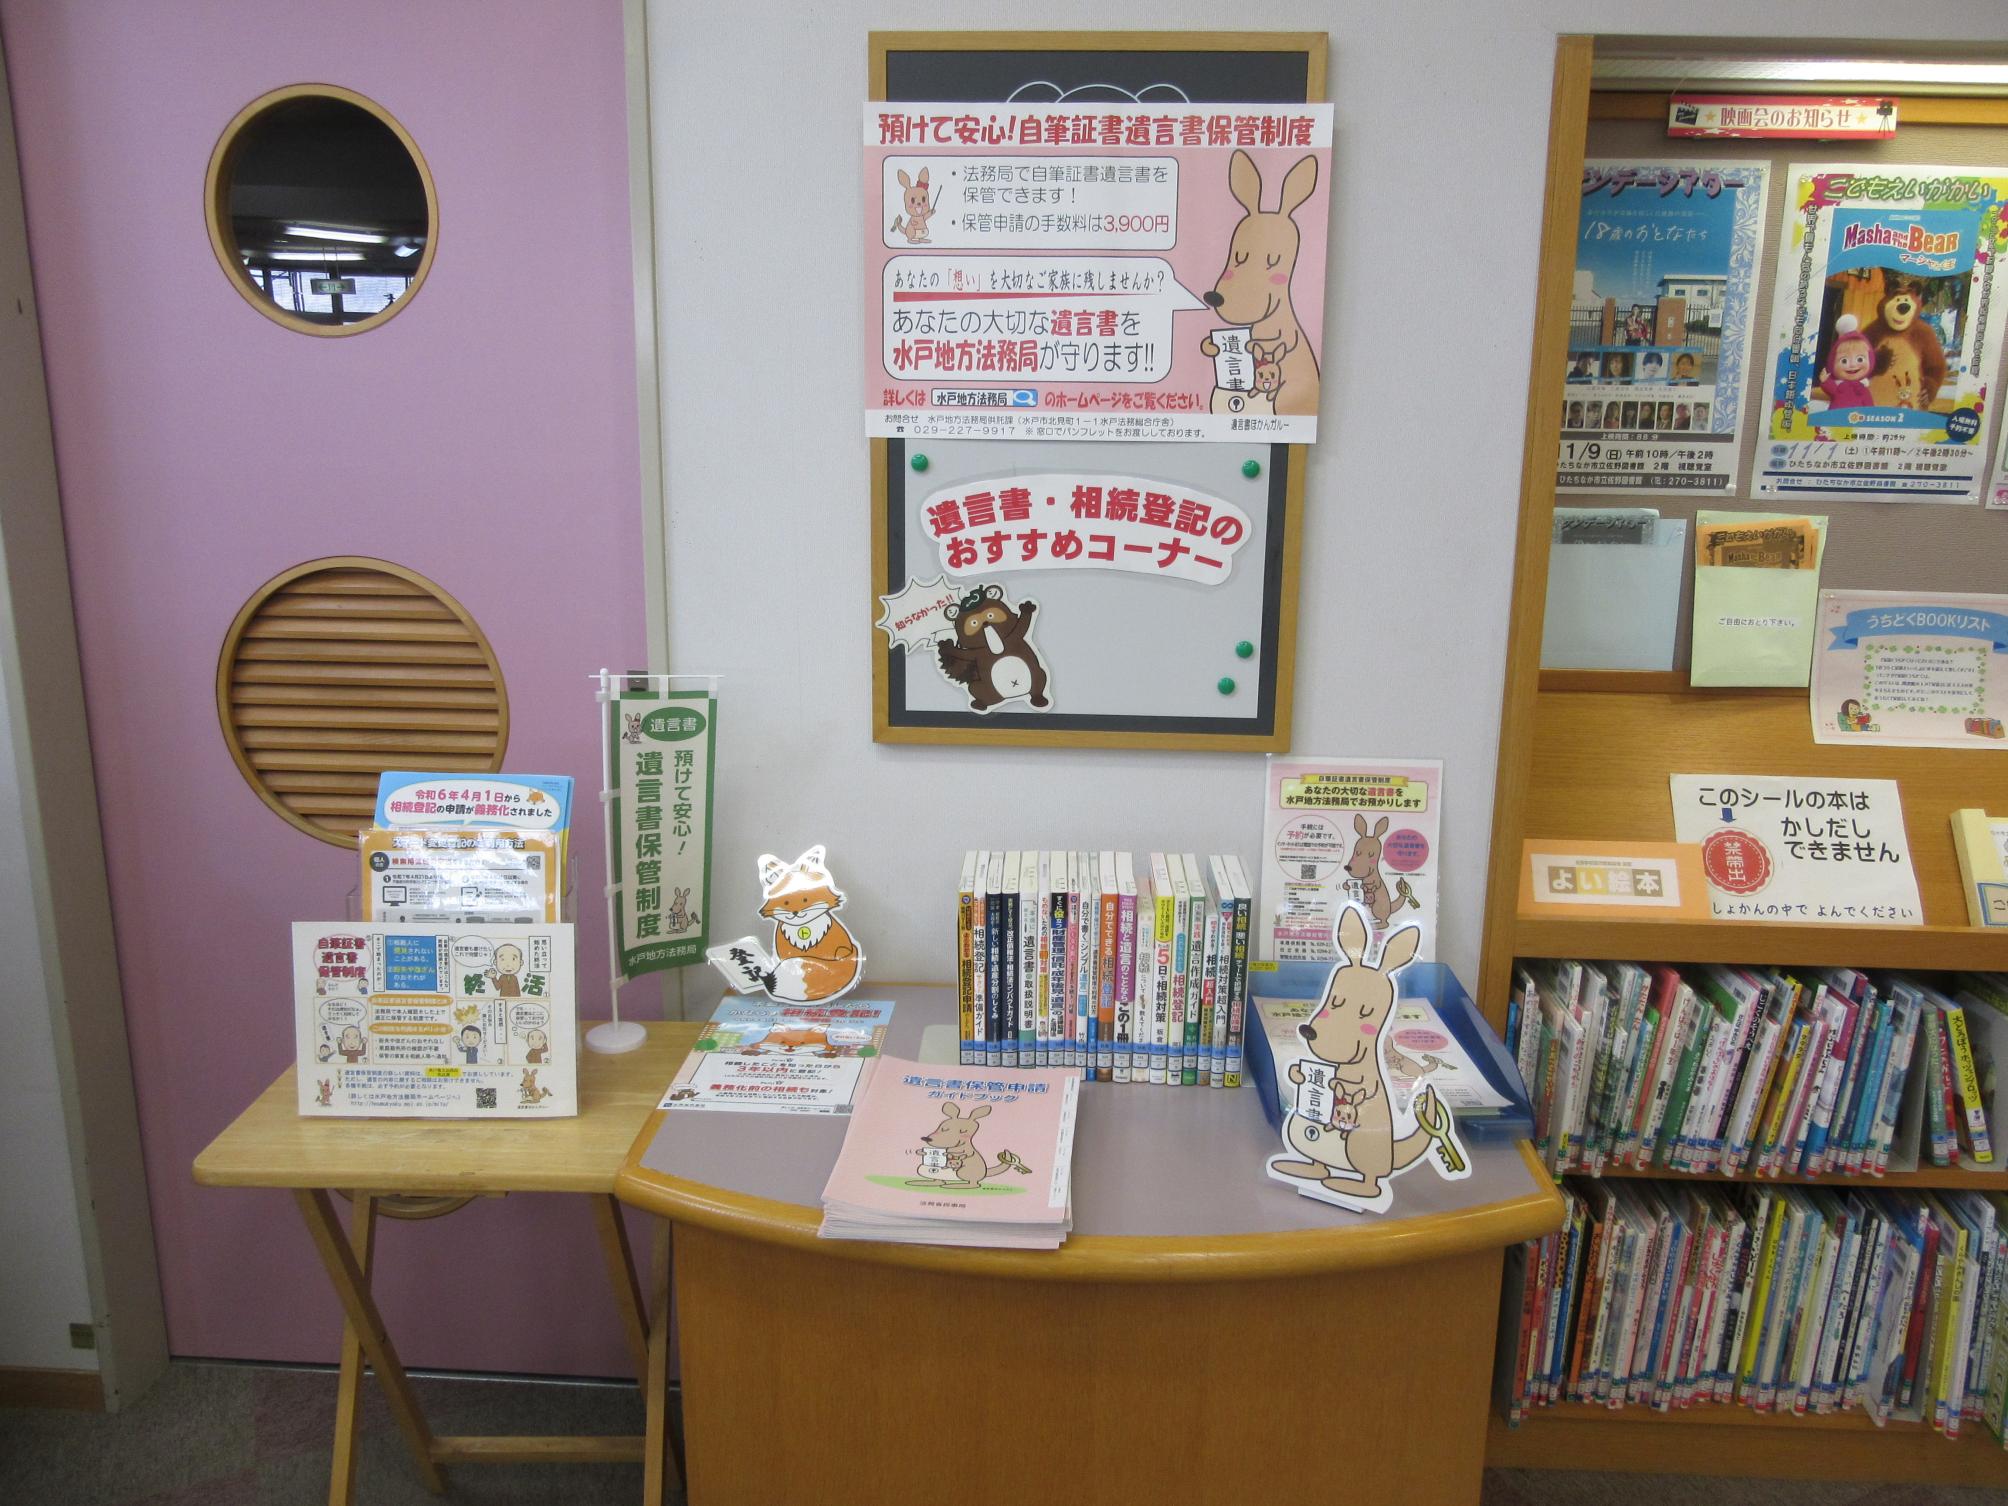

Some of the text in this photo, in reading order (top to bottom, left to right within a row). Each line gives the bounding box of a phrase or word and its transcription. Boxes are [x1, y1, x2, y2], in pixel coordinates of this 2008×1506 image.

[877, 112, 1317, 148] 預けて安心!自筆証書遺言書保管制度
[1720, 107, 1854, 130] 映画会のお知らせ
[1824, 175, 1992, 202] こどもえいがかい
[1842, 223, 1892, 250] Masha
[892, 308, 1141, 337] あなたの大切な遺言書を
[1220, 335, 1246, 392] 遺言書
[883, 388, 1205, 412] 詳しくは 水戸地方法務局 のホームページをご覧ください。
[884, 414, 919, 424] お問合せ
[1558, 441, 1601, 461] 1/9
[1557, 461, 1645, 471] たちなか市立佐野図書館
[926, 484, 1244, 546] 遺言書・相続登記の
[945, 528, 1224, 570] おすすめコーナー
[1718, 618, 1796, 628] ご自由におとり下さい。
[650, 716, 697, 732] 遺言書
[672, 749, 694, 856] 預けて安心！
[1286, 796, 1422, 809] 水戸地方法務局でお預かりします
[1304, 785, 1404, 798] あなたの大切な遺言書を
[1698, 788, 1870, 812] このシールの本は
[390, 802, 553, 818] 相続登記の申請が義務化されました
[1300, 823, 1324, 831] 手続には
[1780, 816, 1872, 840] かしだし
[635, 751, 664, 939] 遺言書保管制度
[1786, 840, 1901, 864] できません
[1723, 840, 1746, 884] 禁帯出
[1551, 868, 1660, 895] よい絵本
[1712, 900, 1914, 921] しょかんの中で よんでください
[322, 951, 359, 964] 遺言書
[628, 944, 697, 967] 水戸地方法務局
[974, 927, 985, 974] 相続登記
[1119, 910, 1134, 1002] 相続と遺言のことなら
[1205, 954, 1217, 978] 相続
[521, 972, 546, 997] 活
[1156, 949, 1170, 1023] 5日で相続対策
[1216, 955, 1228, 1025] 相続対策超入門
[1171, 974, 1185, 1023] 相続登記
[974, 993, 985, 1037] 準備ガイド
[903, 1074, 1050, 1094] 遺言書保管申請
[927, 1090, 1021, 1104] ガイドブック
